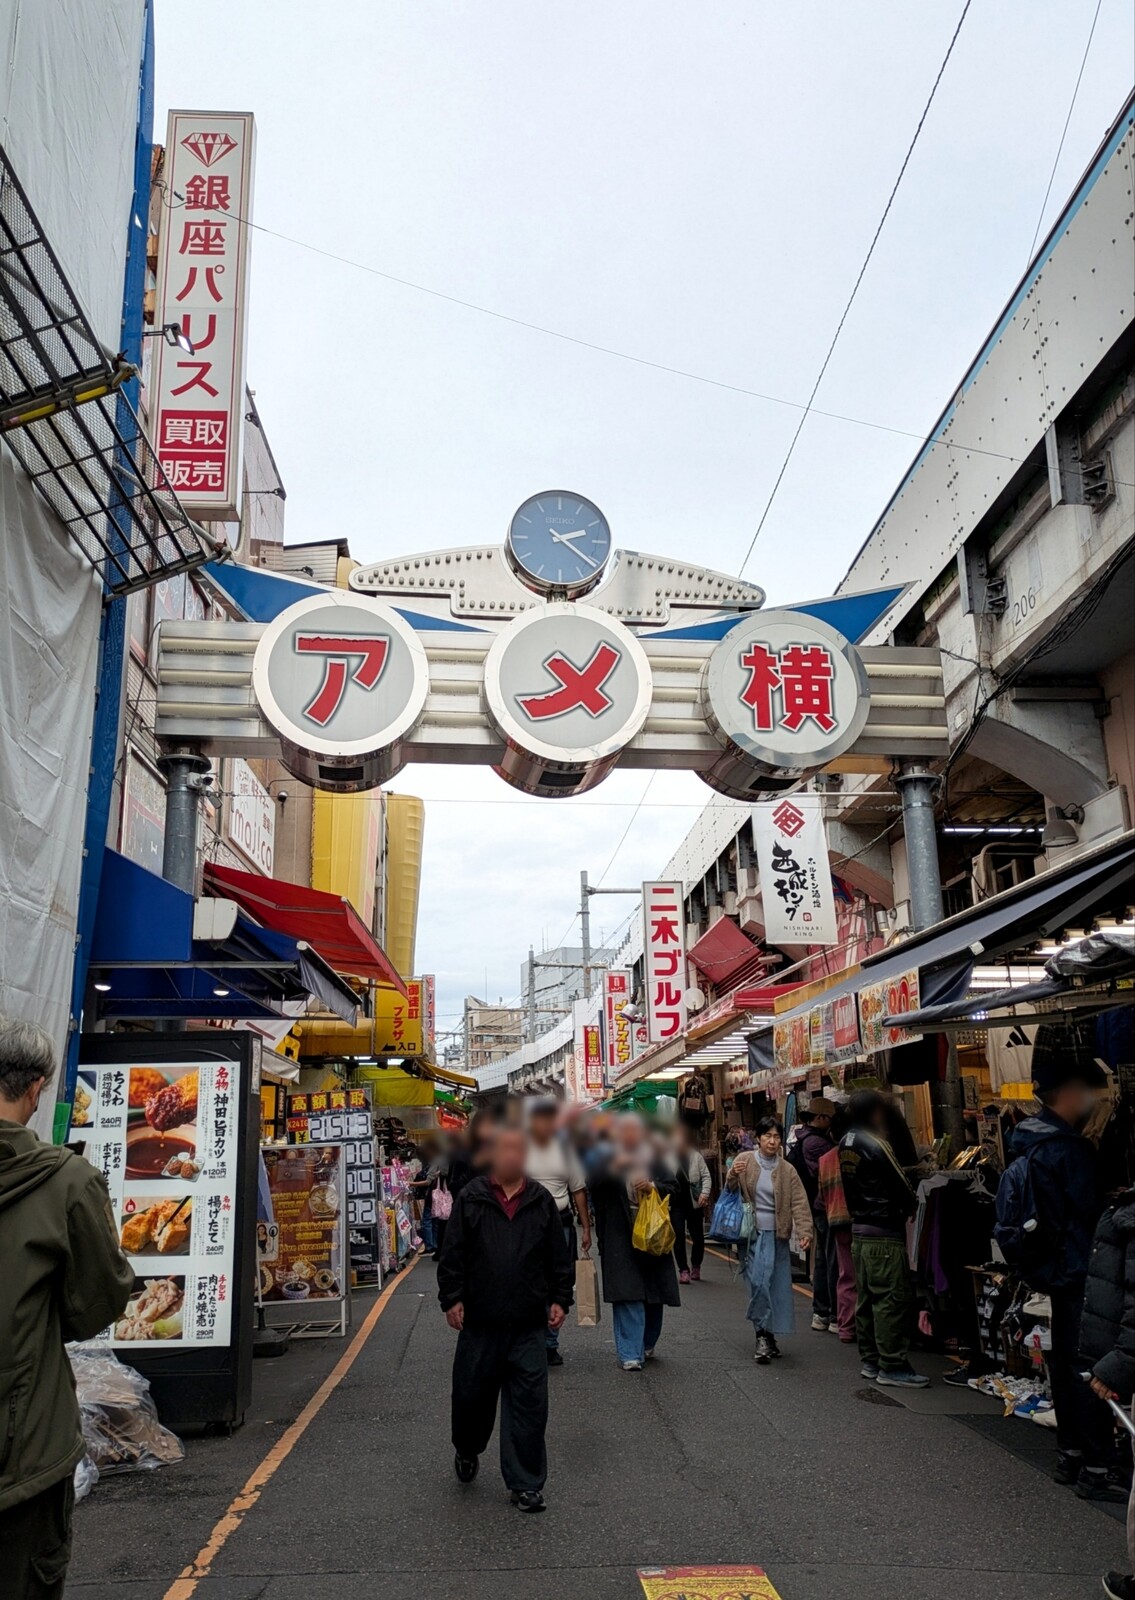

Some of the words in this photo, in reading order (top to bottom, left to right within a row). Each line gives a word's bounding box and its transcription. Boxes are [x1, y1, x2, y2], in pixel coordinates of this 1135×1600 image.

[171, 175, 231, 397] 銀座パリス
[164, 418, 224, 446] 買取
[162, 460, 224, 487] 販売
[545, 516, 575, 525] SEIKO
[1013, 587, 1037, 627] 206
[296, 631, 837, 734] アメ横
[398, 1043, 416, 1051] 入口
[112, 1071, 124, 1106] ちくわ
[215, 1066, 229, 1091] 名物
[292, 1091, 365, 1111] 高額買取
[213, 1093, 229, 1159] 神田旨カツ
[113, 1142, 122, 1168] 一軒めの
[222, 1195, 231, 1211] 名物
[207, 1195, 221, 1243] 揚げたて
[195, 1276, 208, 1327] 一軒め焼売
[208, 1274, 218, 1327] 肉汁たっぷり
